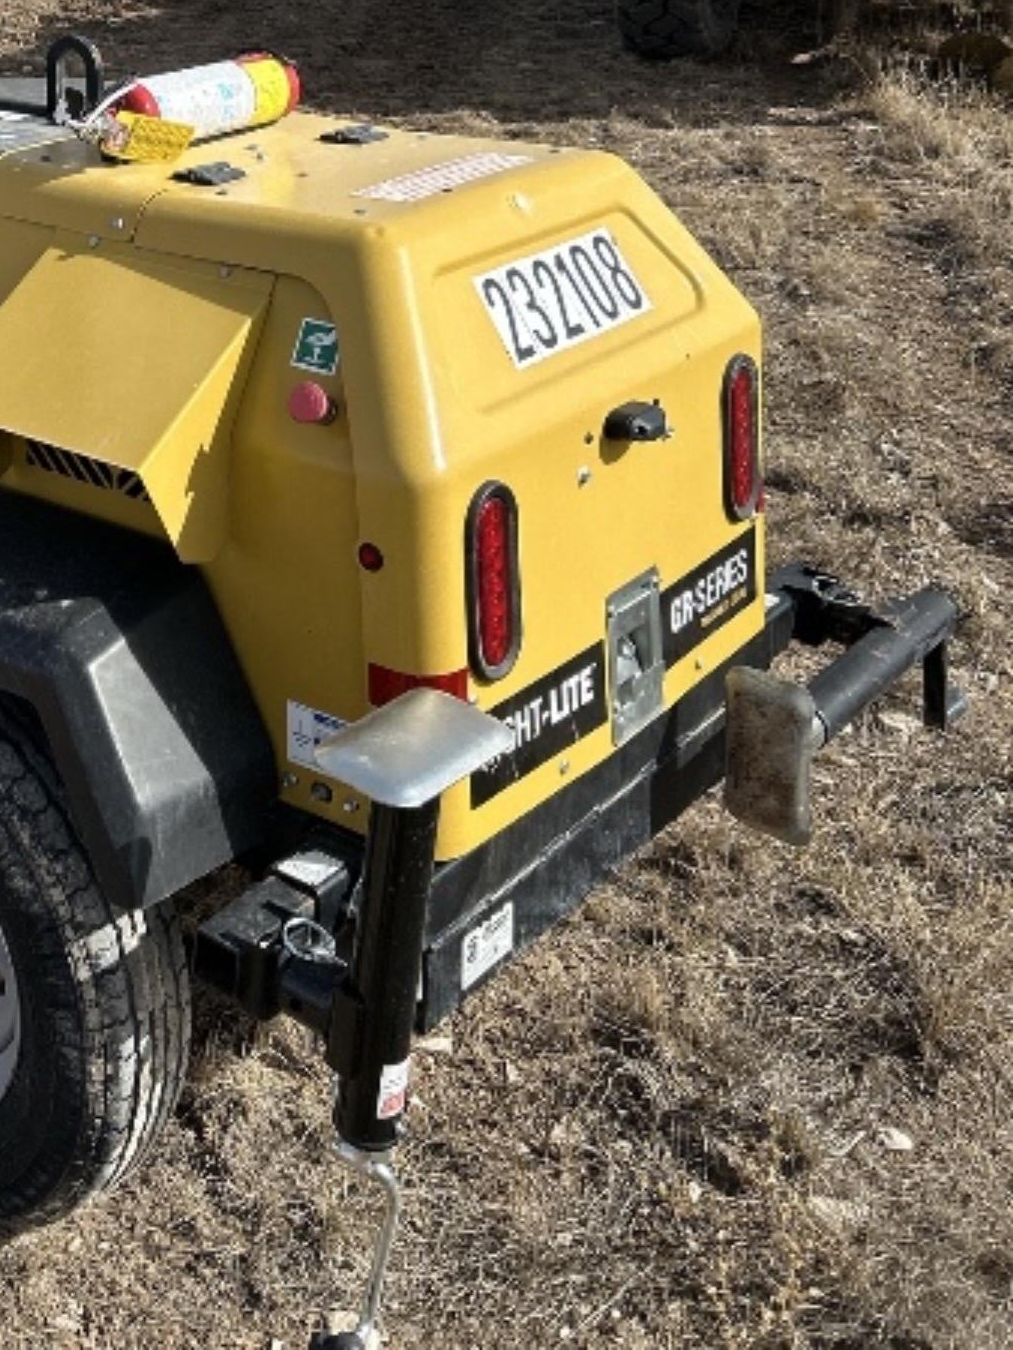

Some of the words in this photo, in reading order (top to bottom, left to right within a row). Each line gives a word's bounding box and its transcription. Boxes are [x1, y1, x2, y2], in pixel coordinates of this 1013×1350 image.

[482, 235, 642, 362] 232108
[670, 548, 748, 634] GR-SERIES
[502, 666, 595, 750] HT-LITE
